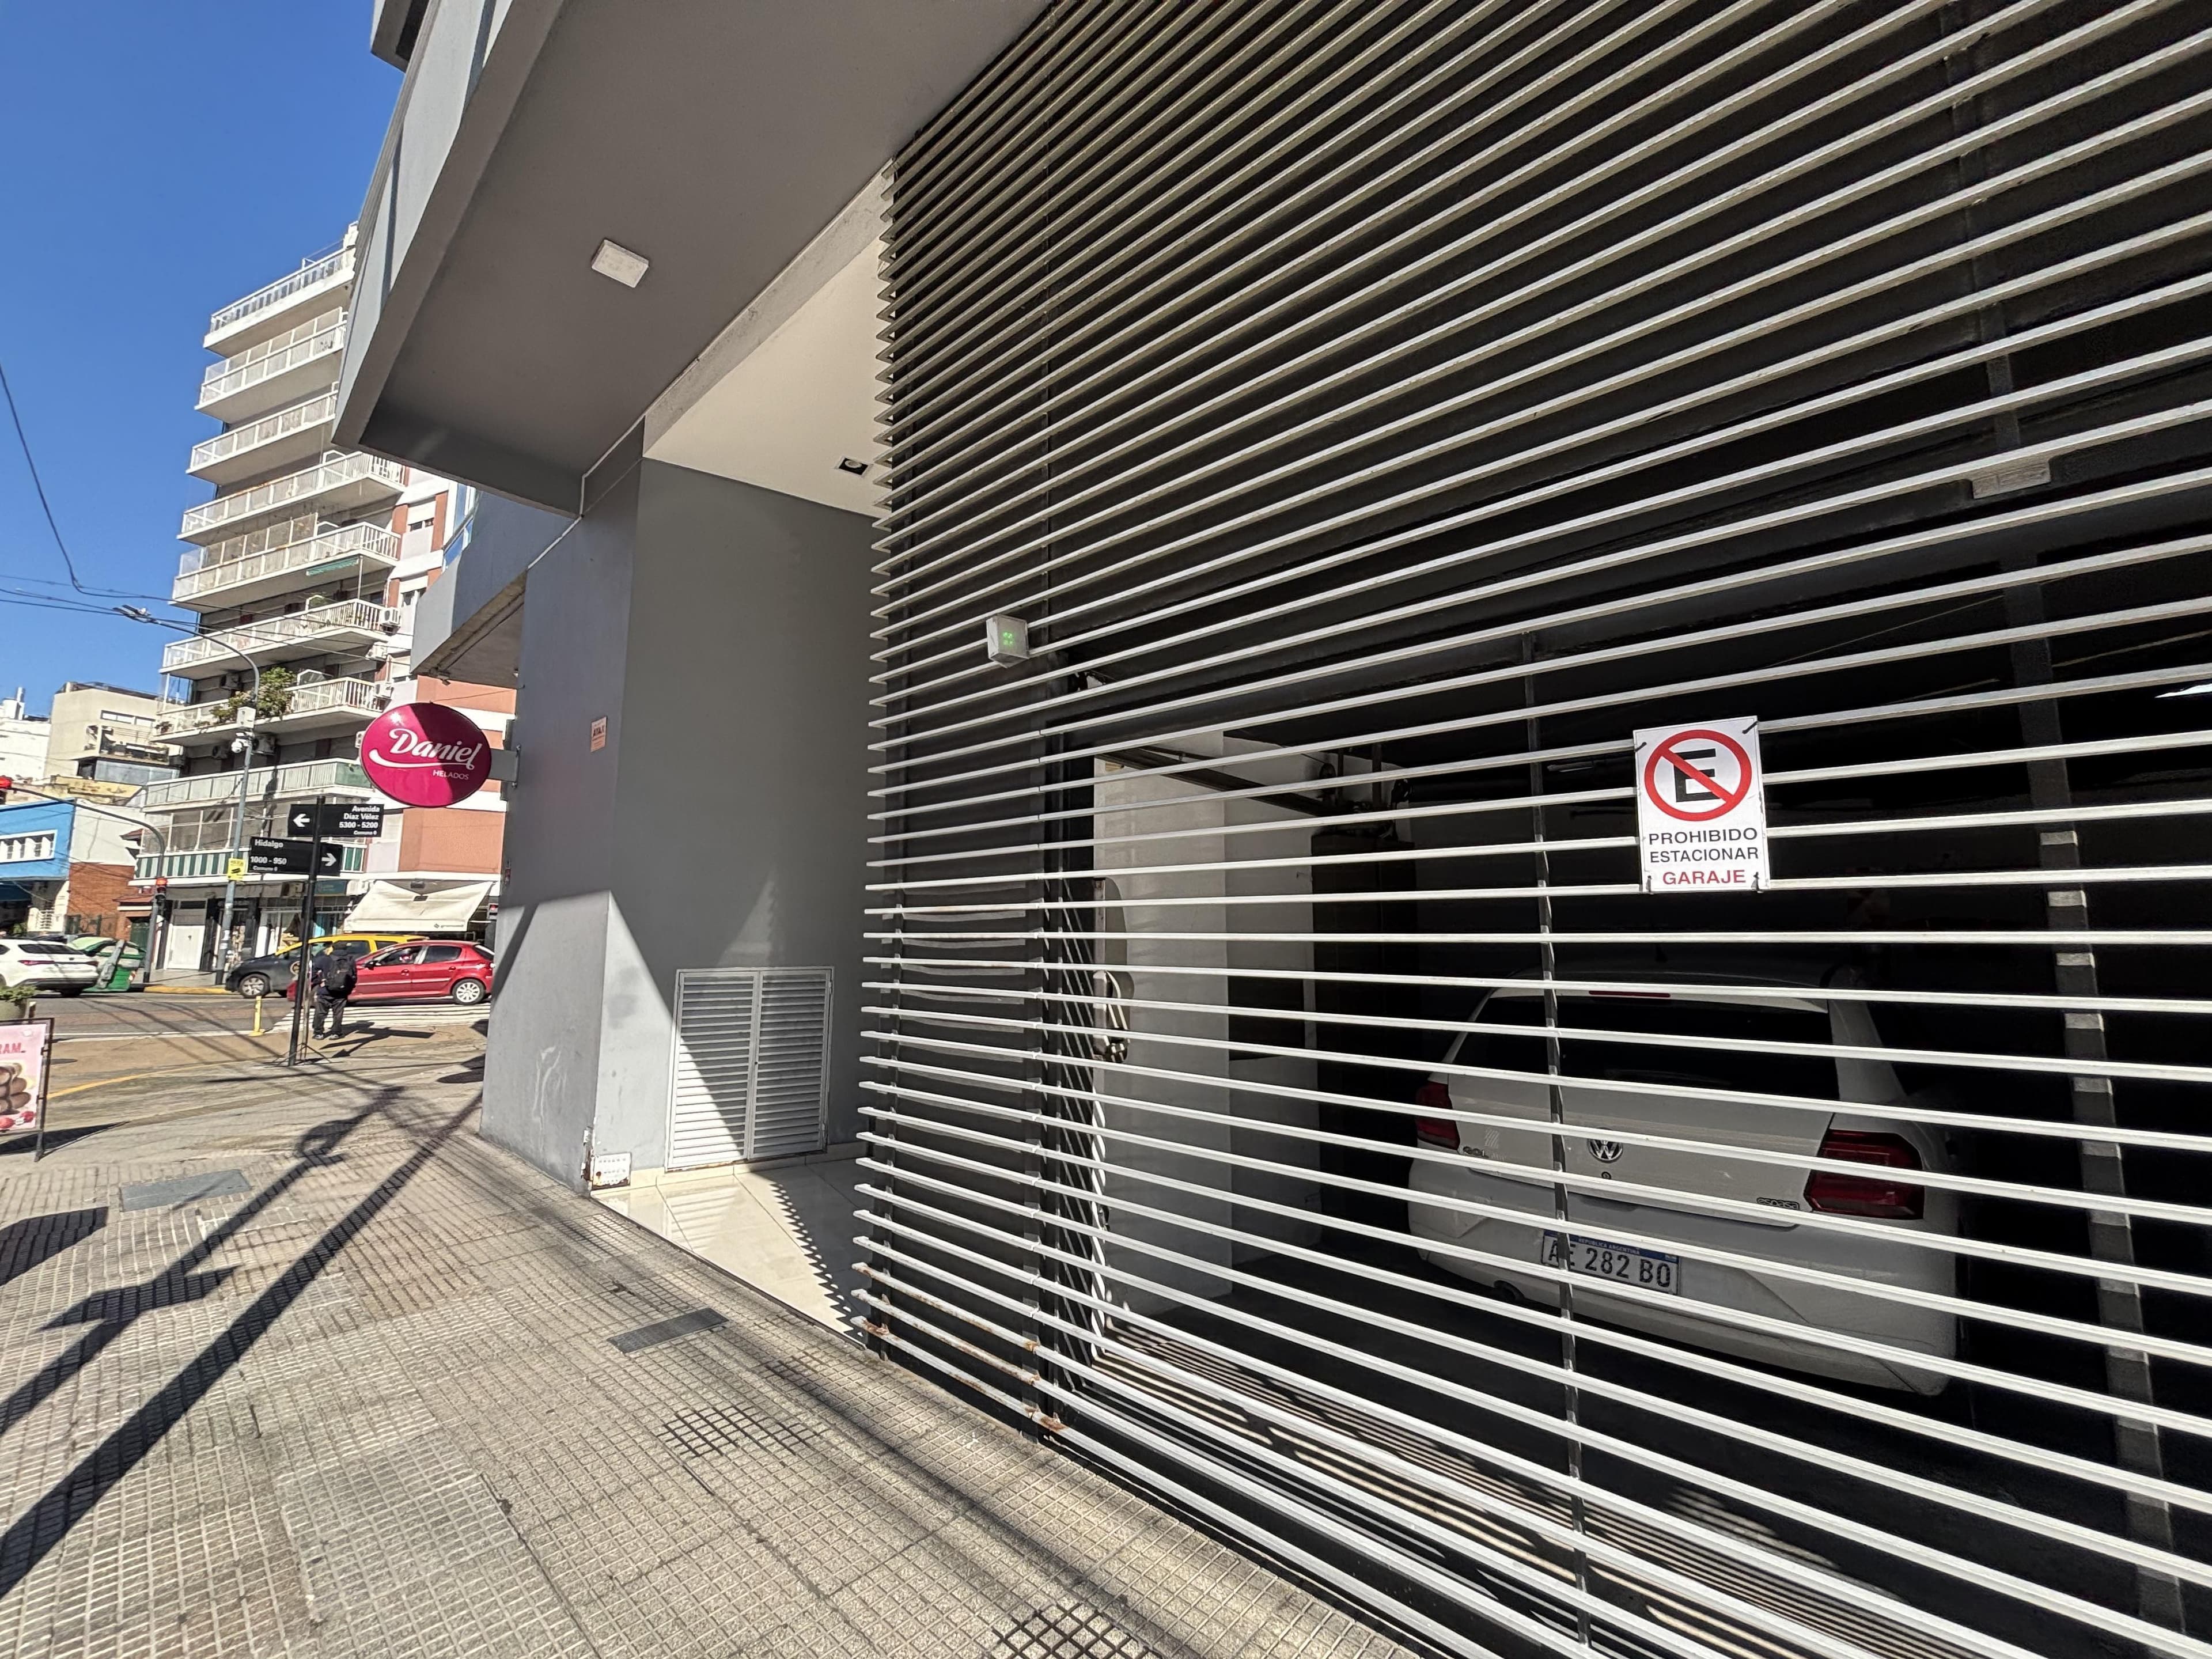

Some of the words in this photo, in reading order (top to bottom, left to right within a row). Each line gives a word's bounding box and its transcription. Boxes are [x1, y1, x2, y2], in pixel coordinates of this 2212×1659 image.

[389, 728, 483, 770] Daniel
[433, 770, 469, 780] HELADOS
[254, 839, 284, 849] Hidalgo
[1649, 827, 1758, 845] PROHIBIDO
[1650, 847, 1759, 863] ESTACIONAR
[1662, 869, 1747, 885] GARAJE
[1585, 1248, 1630, 1279] 282
